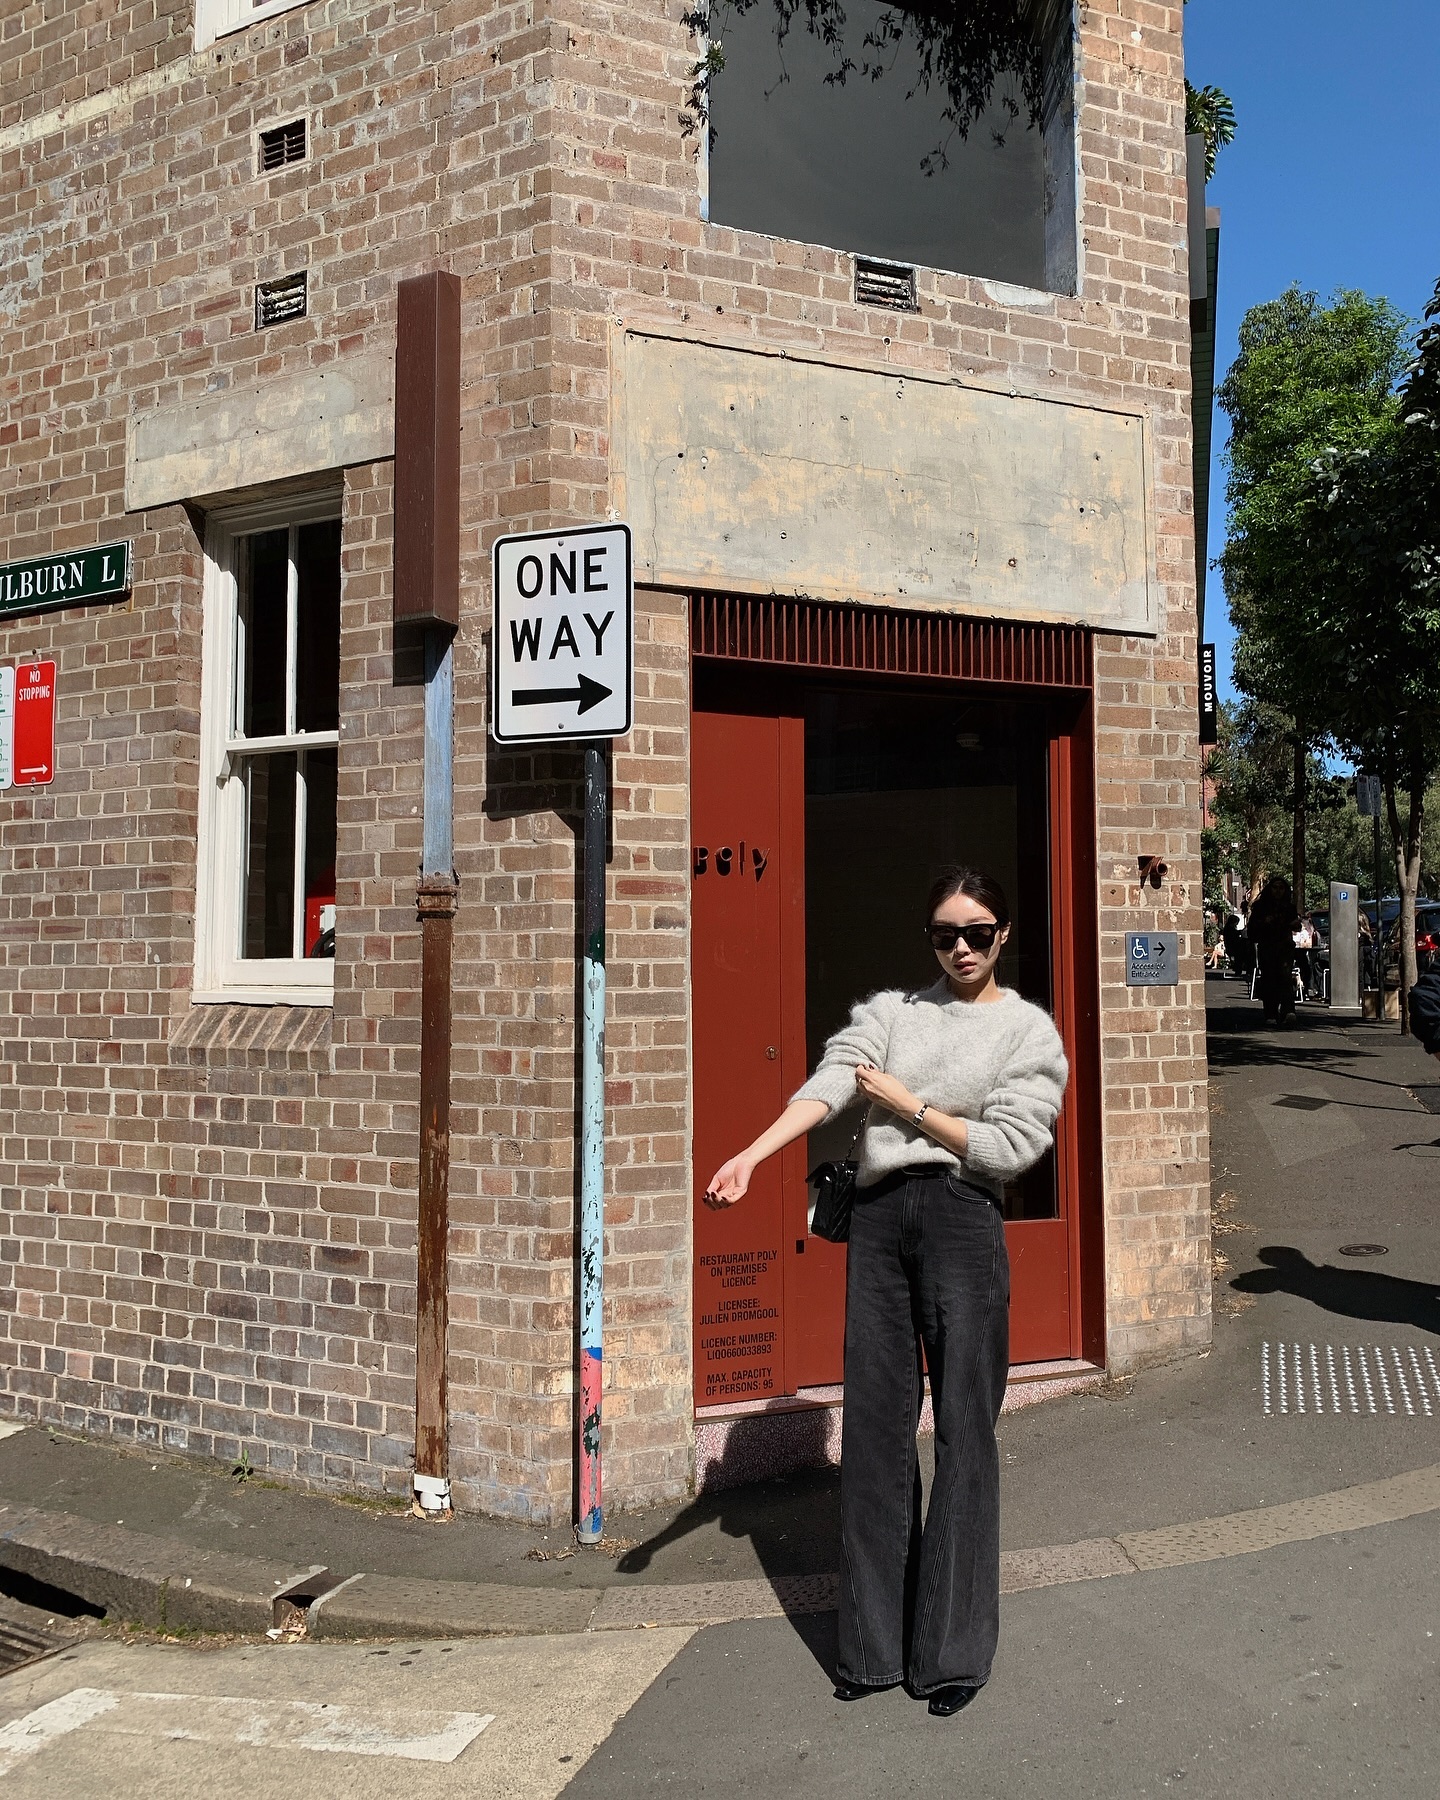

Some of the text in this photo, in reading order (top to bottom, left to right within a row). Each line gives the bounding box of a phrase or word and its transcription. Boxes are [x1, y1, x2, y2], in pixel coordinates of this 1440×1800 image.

[101, 555, 116, 582] L
[516, 547, 608, 598] ONE
[510, 611, 615, 662] WAY
[29, 670, 41, 683] NO
[1203, 650, 1213, 712] MOUVOIR
[18, 685, 51, 701] STOPPING
[693, 841, 771, 882] poly
[1131, 970, 1160, 978] Entrance
[700, 1250, 777, 1266] RESTAURANT POLY
[711, 1263, 767, 1277] ON PREMISES
[722, 1276, 757, 1288] LICENCE
[718, 1298, 760, 1311] LICENSEE:
[700, 1308, 779, 1325] JULIEN DROMGOOL
[701, 1332, 777, 1349] LICENCE NUMBER:
[707, 1367, 772, 1384] MAX. CAPACITY
[706, 1379, 773, 1396] OF PERSONS: 95
